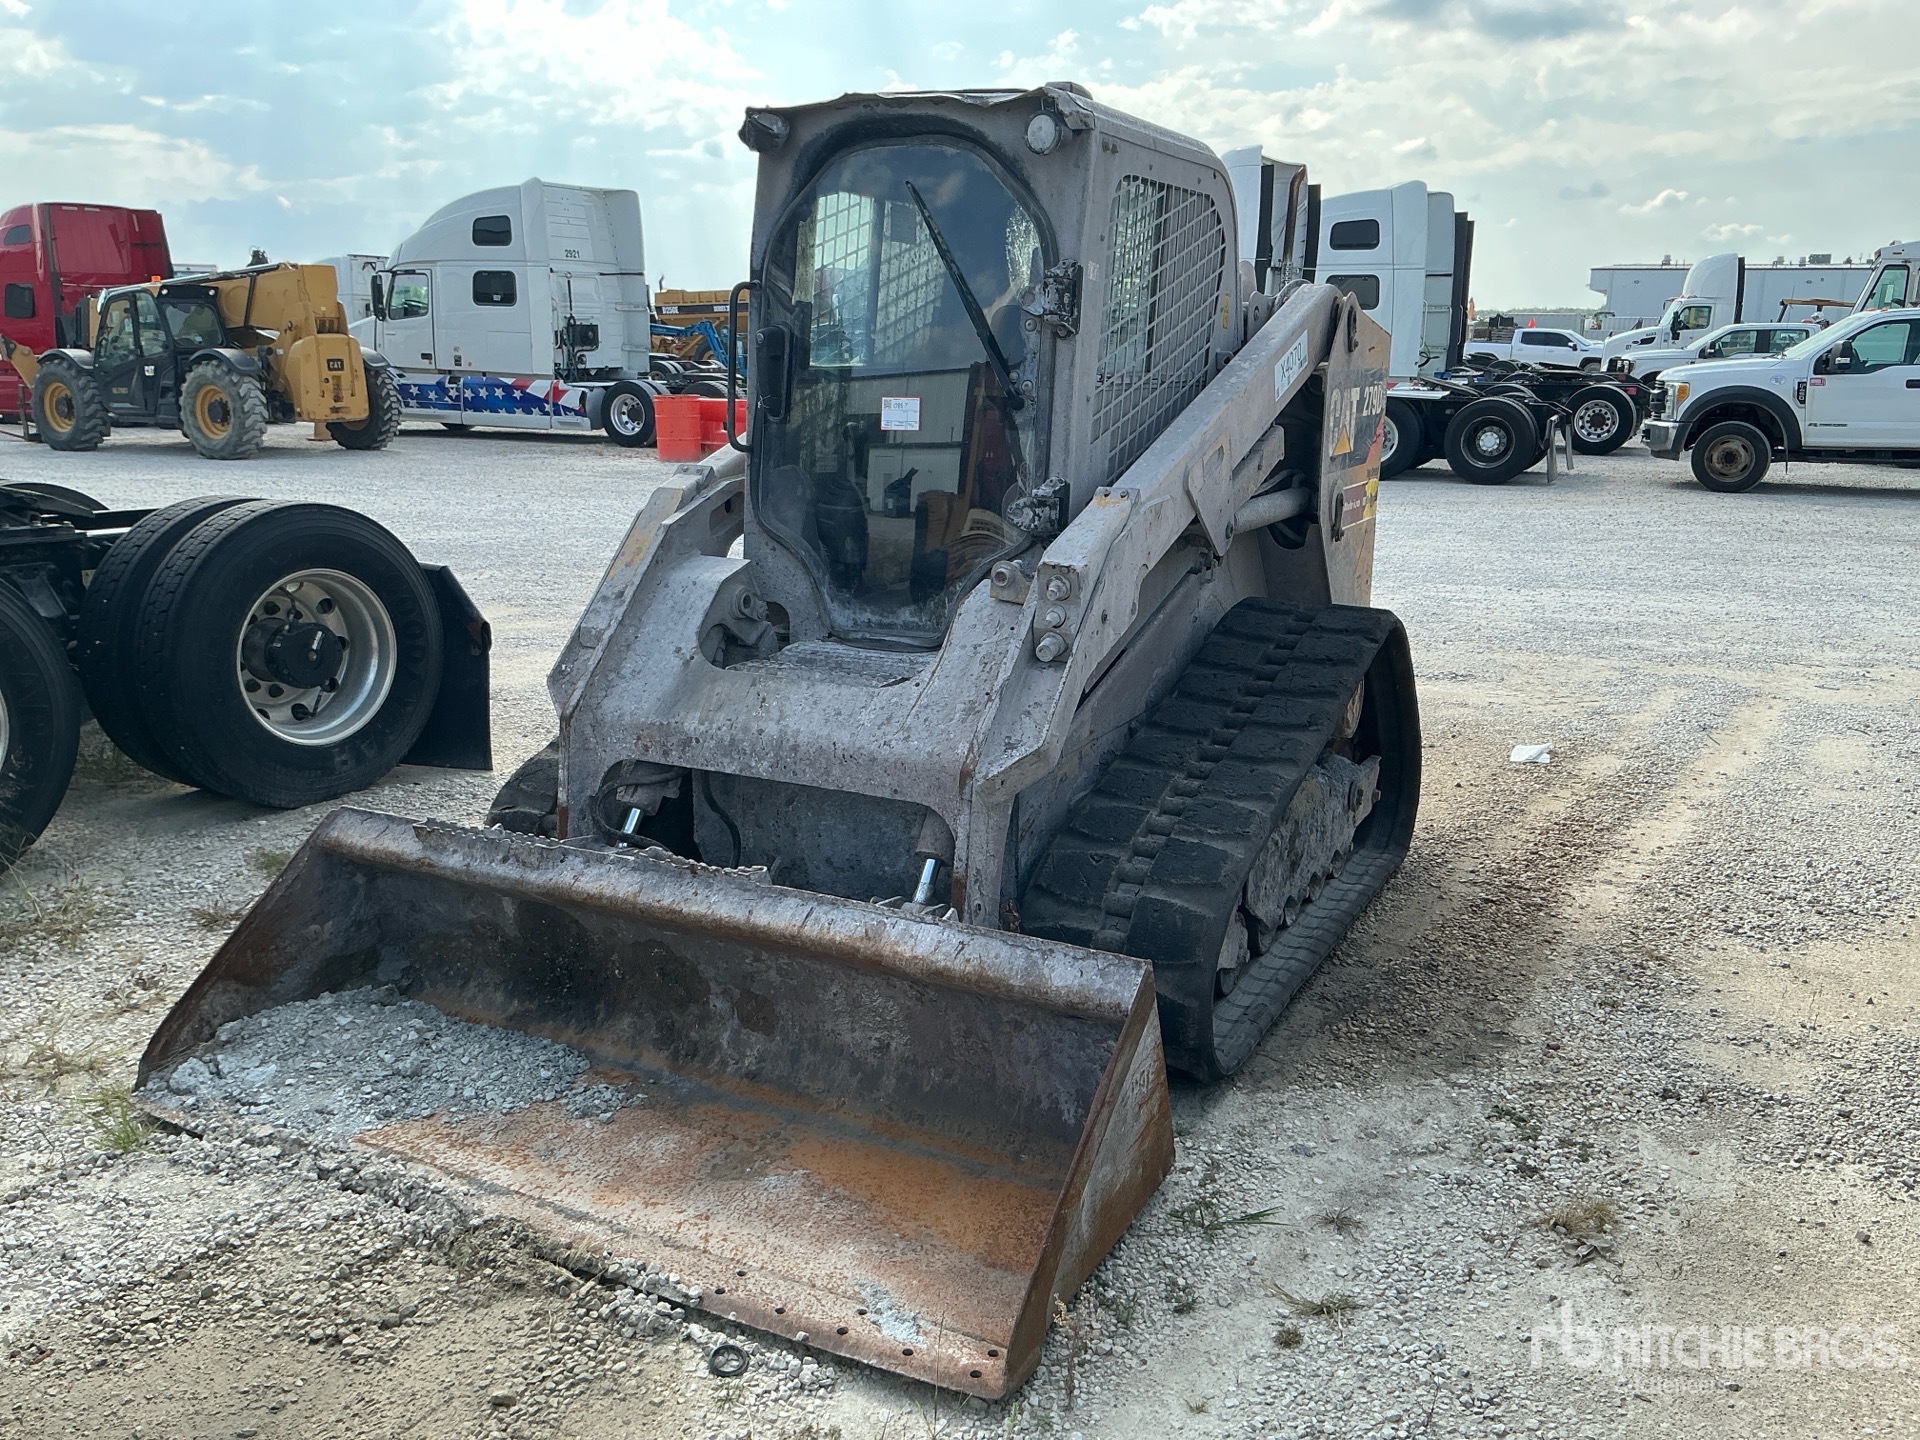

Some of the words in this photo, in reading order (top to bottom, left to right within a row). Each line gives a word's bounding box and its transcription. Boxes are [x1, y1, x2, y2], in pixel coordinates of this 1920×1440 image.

[564, 249, 580, 259] 2921
[329, 361, 342, 369] CAT
[1329, 387, 1360, 457] CAT
